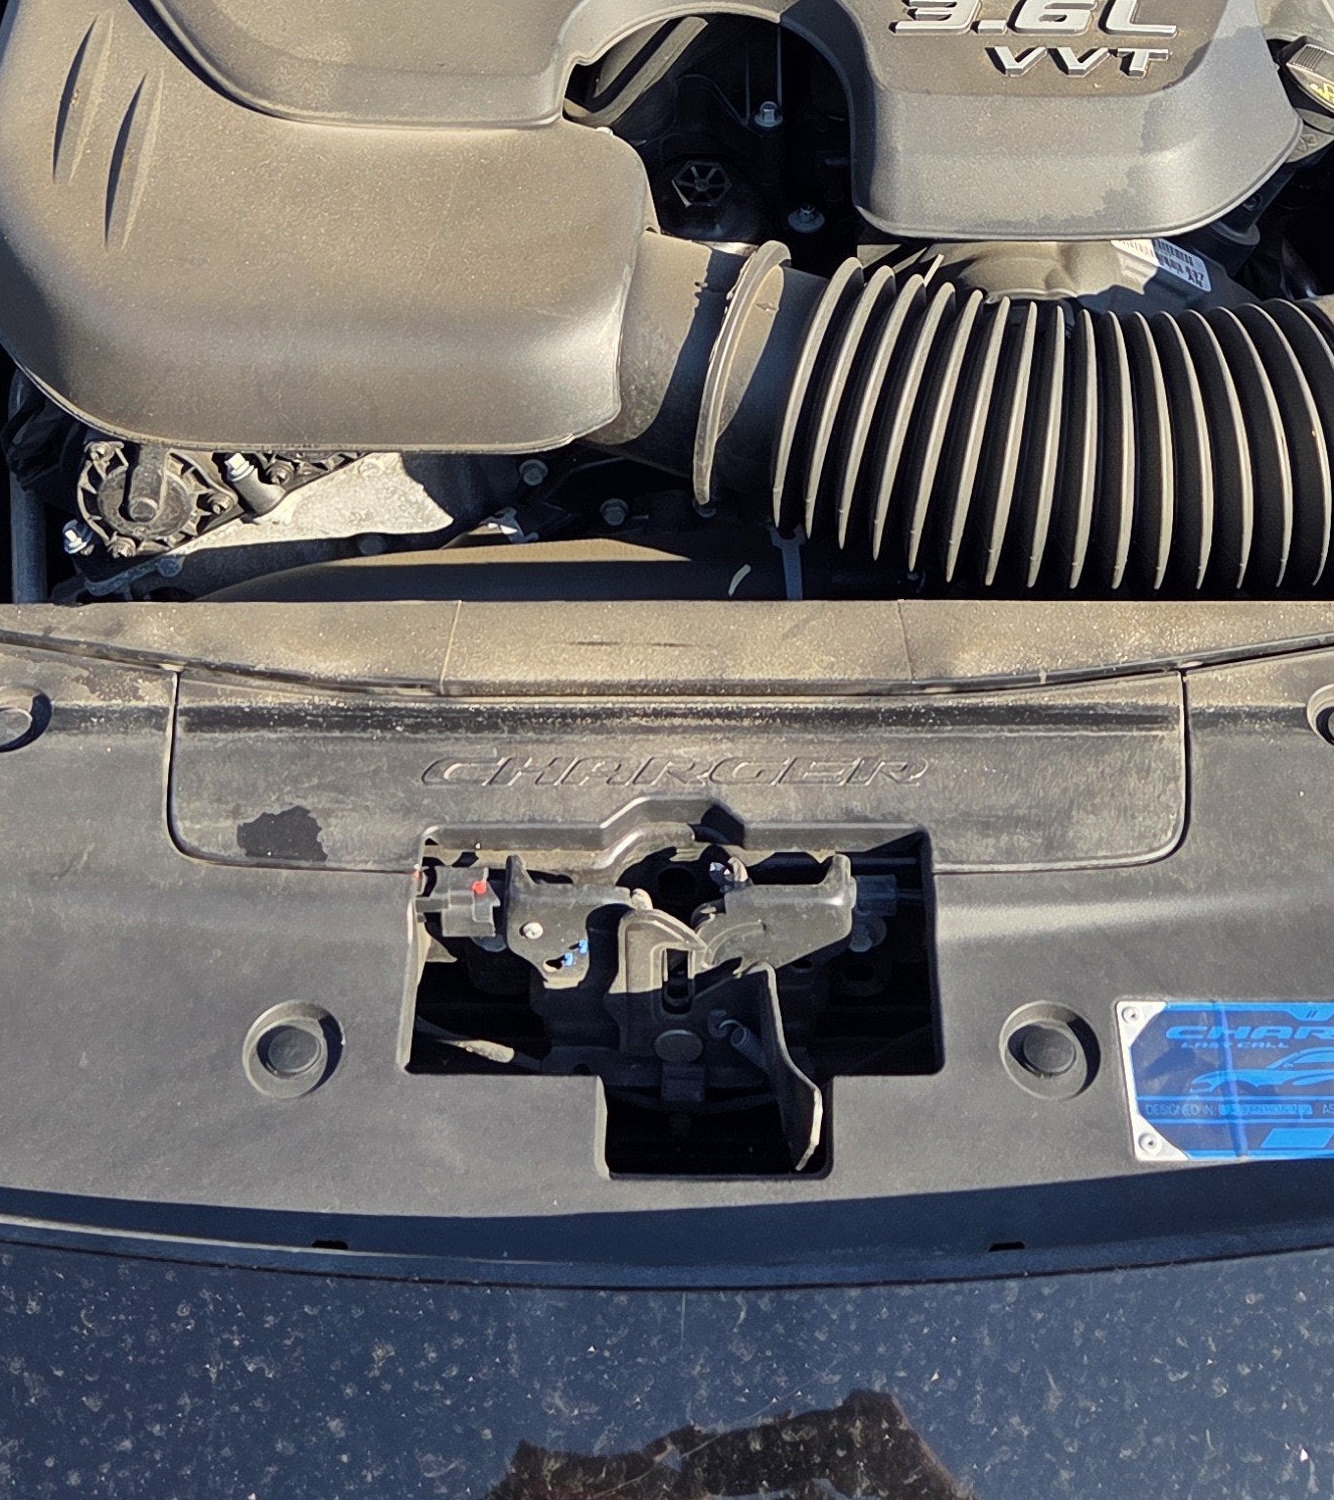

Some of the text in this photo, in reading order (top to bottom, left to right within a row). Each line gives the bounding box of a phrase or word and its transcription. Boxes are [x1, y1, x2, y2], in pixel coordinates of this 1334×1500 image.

[986, 46, 1170, 78] VVT
[420, 754, 930, 787] CHARGER
[1237, 1041, 1289, 1049] CALL
